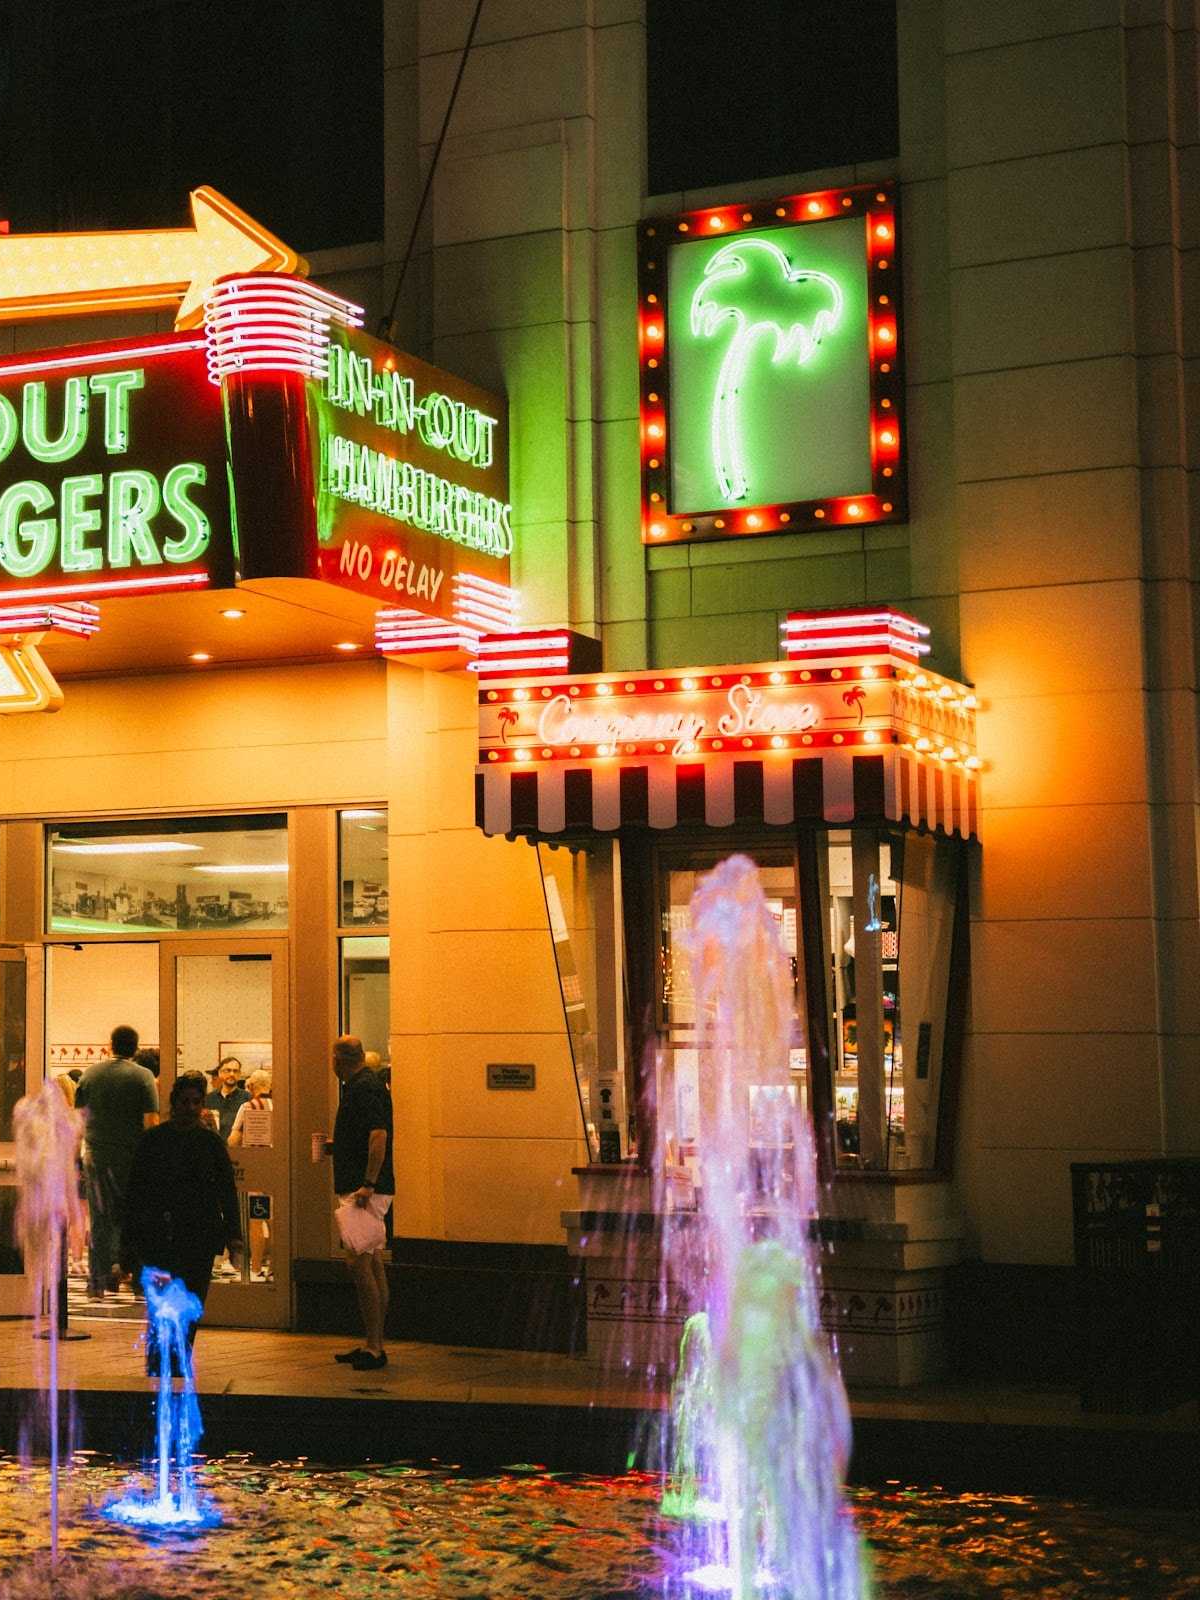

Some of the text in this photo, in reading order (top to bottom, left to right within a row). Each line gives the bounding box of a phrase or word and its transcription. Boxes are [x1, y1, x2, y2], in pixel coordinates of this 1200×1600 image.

[321, 344, 498, 469] IN-N-OUT
[321, 431, 513, 558] HAMBURGERS
[339, 540, 444, 602] NO DELAY
[538, 683, 820, 758] Company Store
